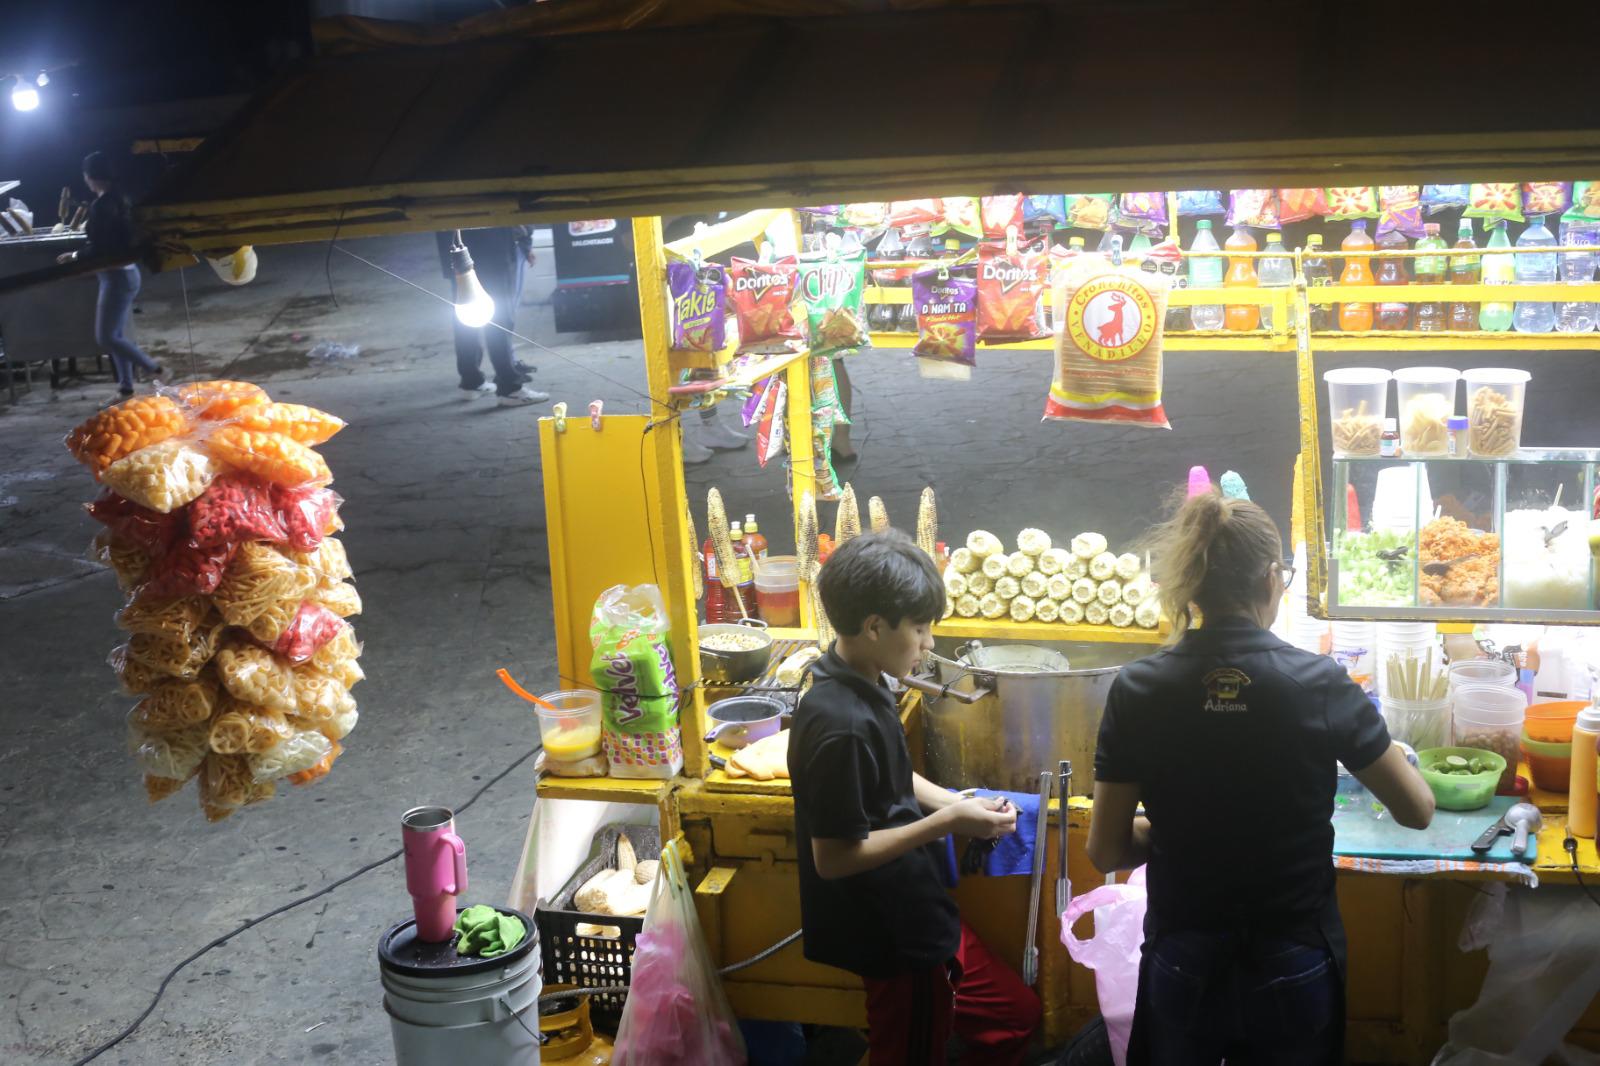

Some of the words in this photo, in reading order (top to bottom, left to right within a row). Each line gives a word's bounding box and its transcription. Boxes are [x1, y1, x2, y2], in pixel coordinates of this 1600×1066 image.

[983, 263, 1038, 280] Doritos
[736, 274, 790, 292] Doritos
[931, 285, 960, 296] Doritos
[674, 289, 716, 325] Takis
[1204, 698, 1247, 711] Adriana
